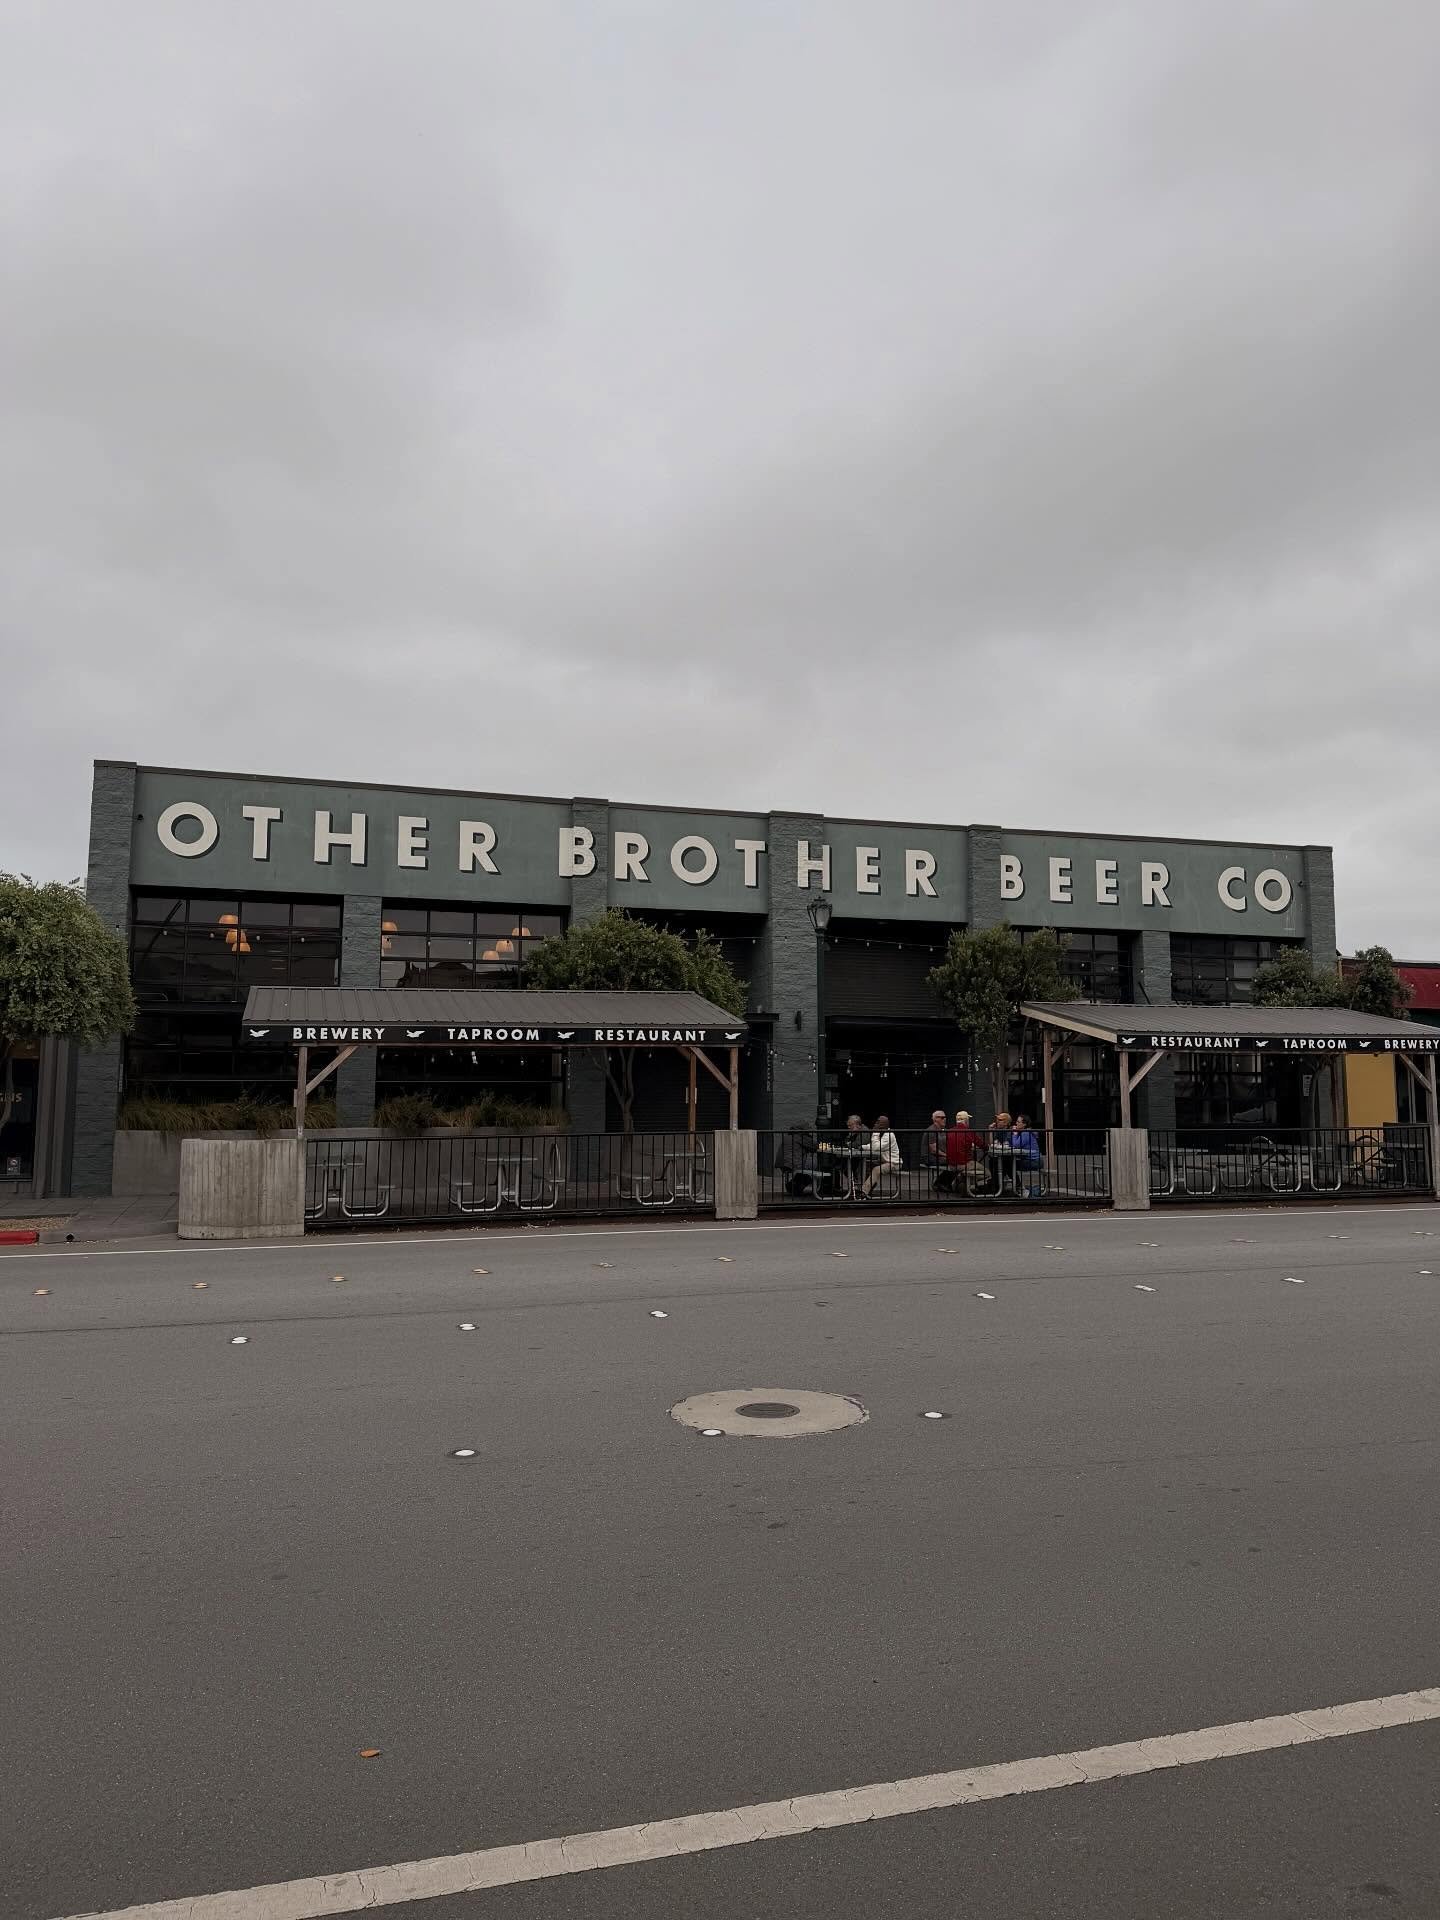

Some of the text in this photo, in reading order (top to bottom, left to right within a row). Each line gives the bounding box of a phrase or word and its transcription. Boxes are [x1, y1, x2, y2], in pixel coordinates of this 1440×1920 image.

[157, 801, 1292, 912] OTHER BROTHER BEER CO
[292, 1027, 707, 1042] BREWERY TAPROOM RESTAURANT
[1151, 1036, 1440, 1050] RESTAURANT TAPROOM BREWERY
